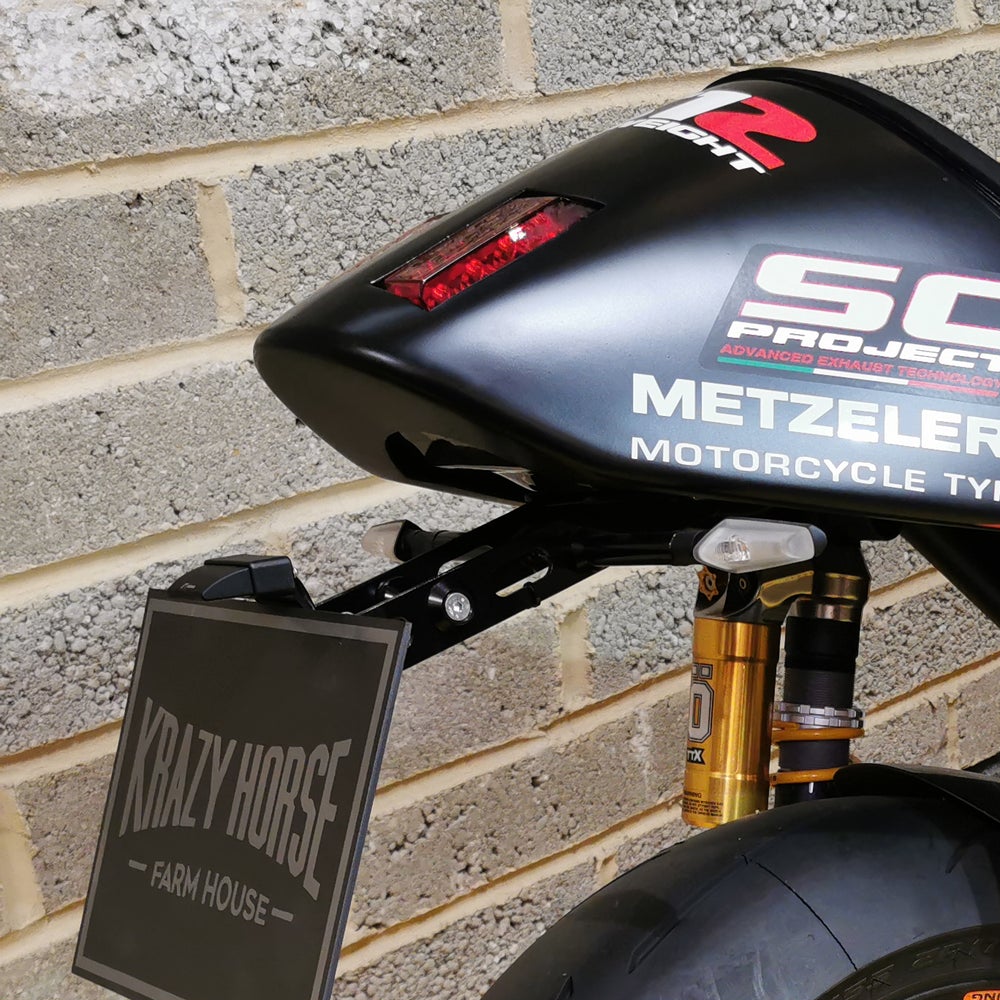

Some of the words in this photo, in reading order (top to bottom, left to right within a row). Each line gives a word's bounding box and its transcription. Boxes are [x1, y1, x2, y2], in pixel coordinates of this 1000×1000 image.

[719, 343, 814, 366] ADVANCED
[816, 354, 894, 377] EXHAUST
[630, 436, 926, 492] MOTORCYCLE
[119, 697, 238, 838] KRAZY
[226, 738, 353, 901] HORSE
[150, 860, 202, 901] FARM
[201, 869, 271, 926] HOUSE
